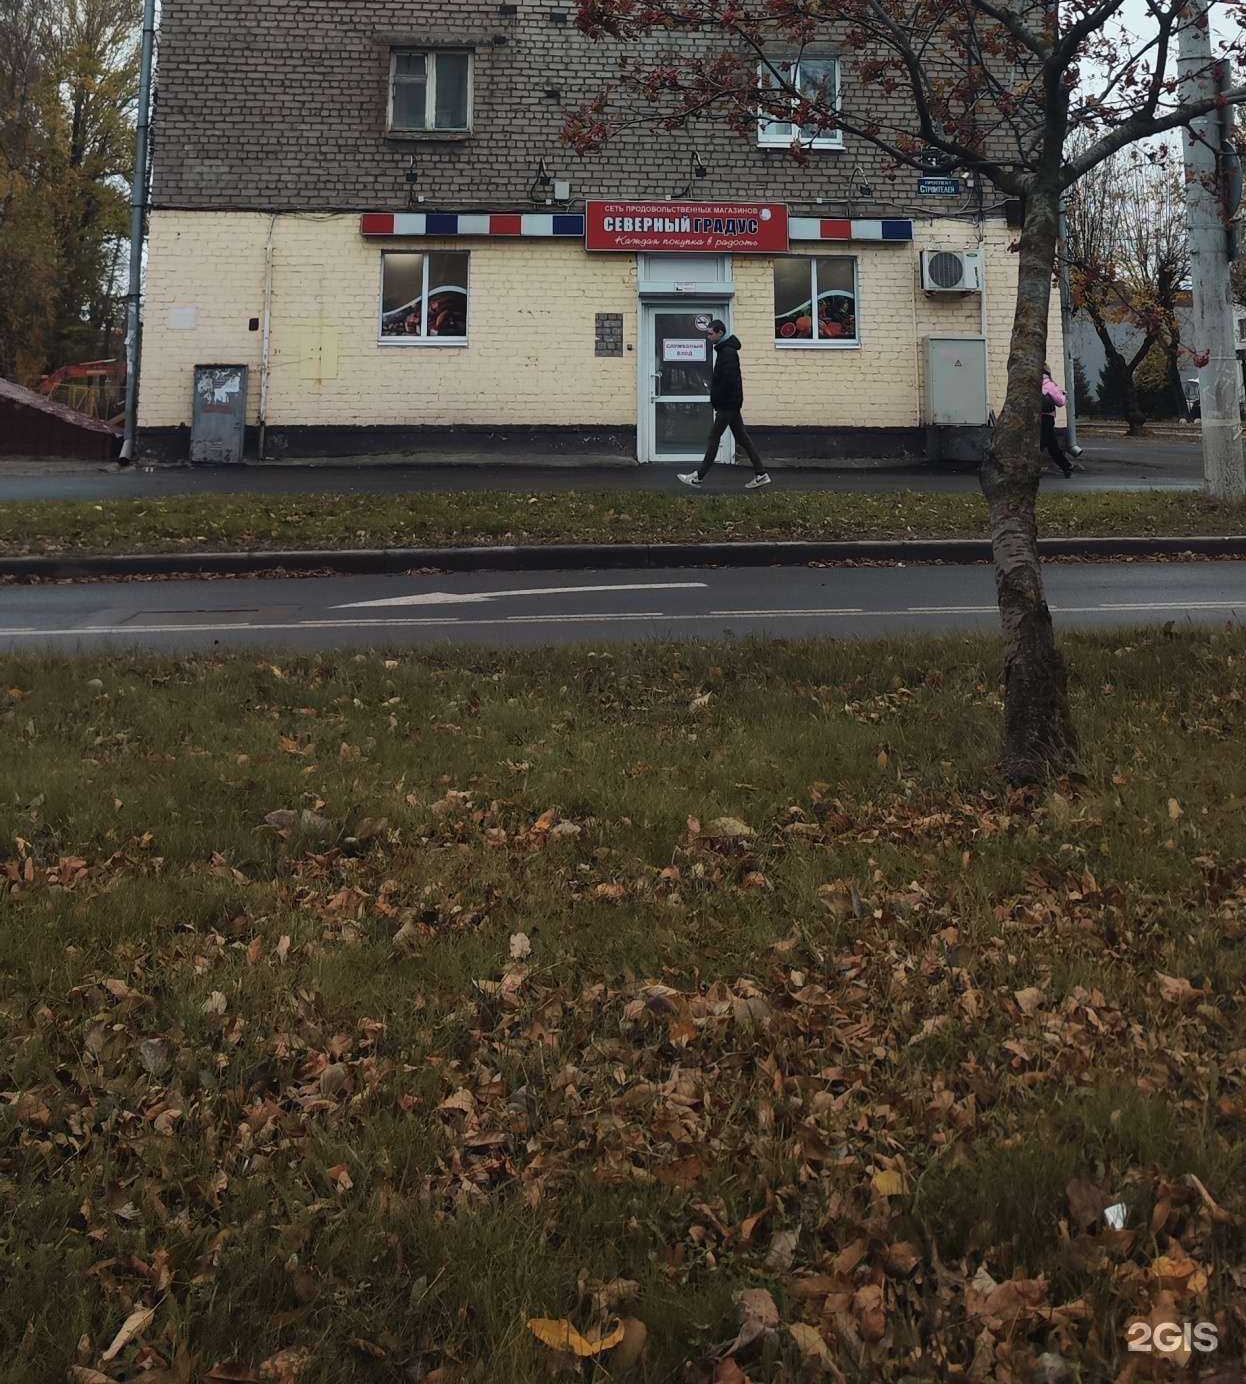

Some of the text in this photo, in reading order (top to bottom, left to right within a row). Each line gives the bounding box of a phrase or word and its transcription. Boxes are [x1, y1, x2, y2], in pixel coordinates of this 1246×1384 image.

[604, 205, 624, 213] СЕТЬ
[625, 205, 712, 214] ПРОДОВОЛЬСТВЕННЫХ
[603, 216, 759, 236] СЕВЕРНЫЙ ГРАДУС
[615, 235, 660, 247] Каждая
[662, 238, 704, 248] покупка
[714, 238, 759, 249] радость
